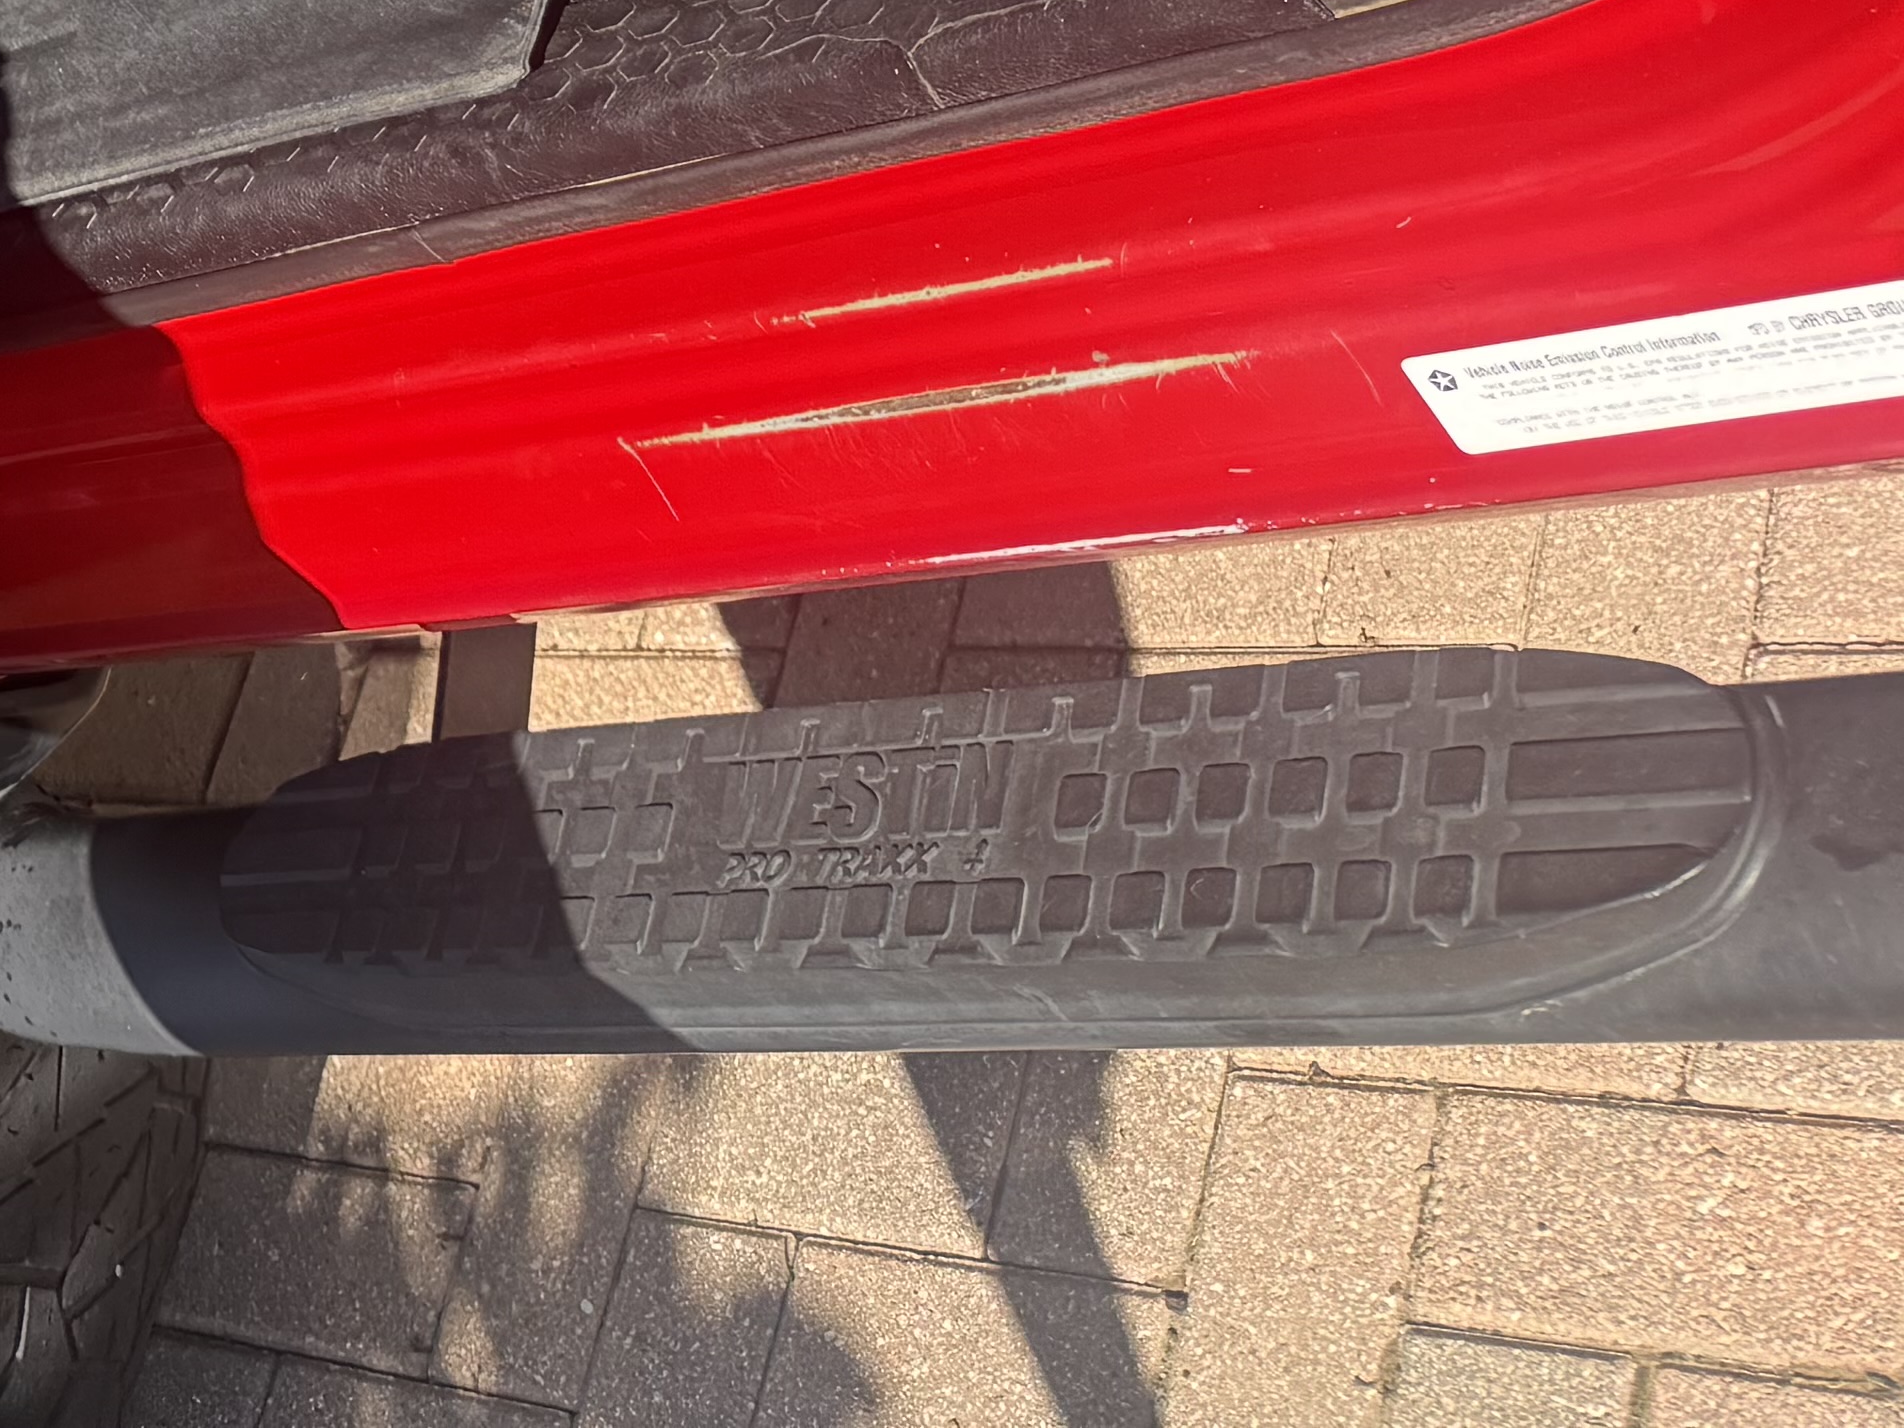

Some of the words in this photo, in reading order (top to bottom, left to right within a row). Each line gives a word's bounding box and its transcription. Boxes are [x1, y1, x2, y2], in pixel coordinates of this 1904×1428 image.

[1787, 306, 1868, 331] CHRYSLER
[1600, 341, 1648, 358] Control
[1645, 332, 1721, 352] Information
[715, 848, 794, 889] PRO
[815, 841, 942, 883] TRAXX
